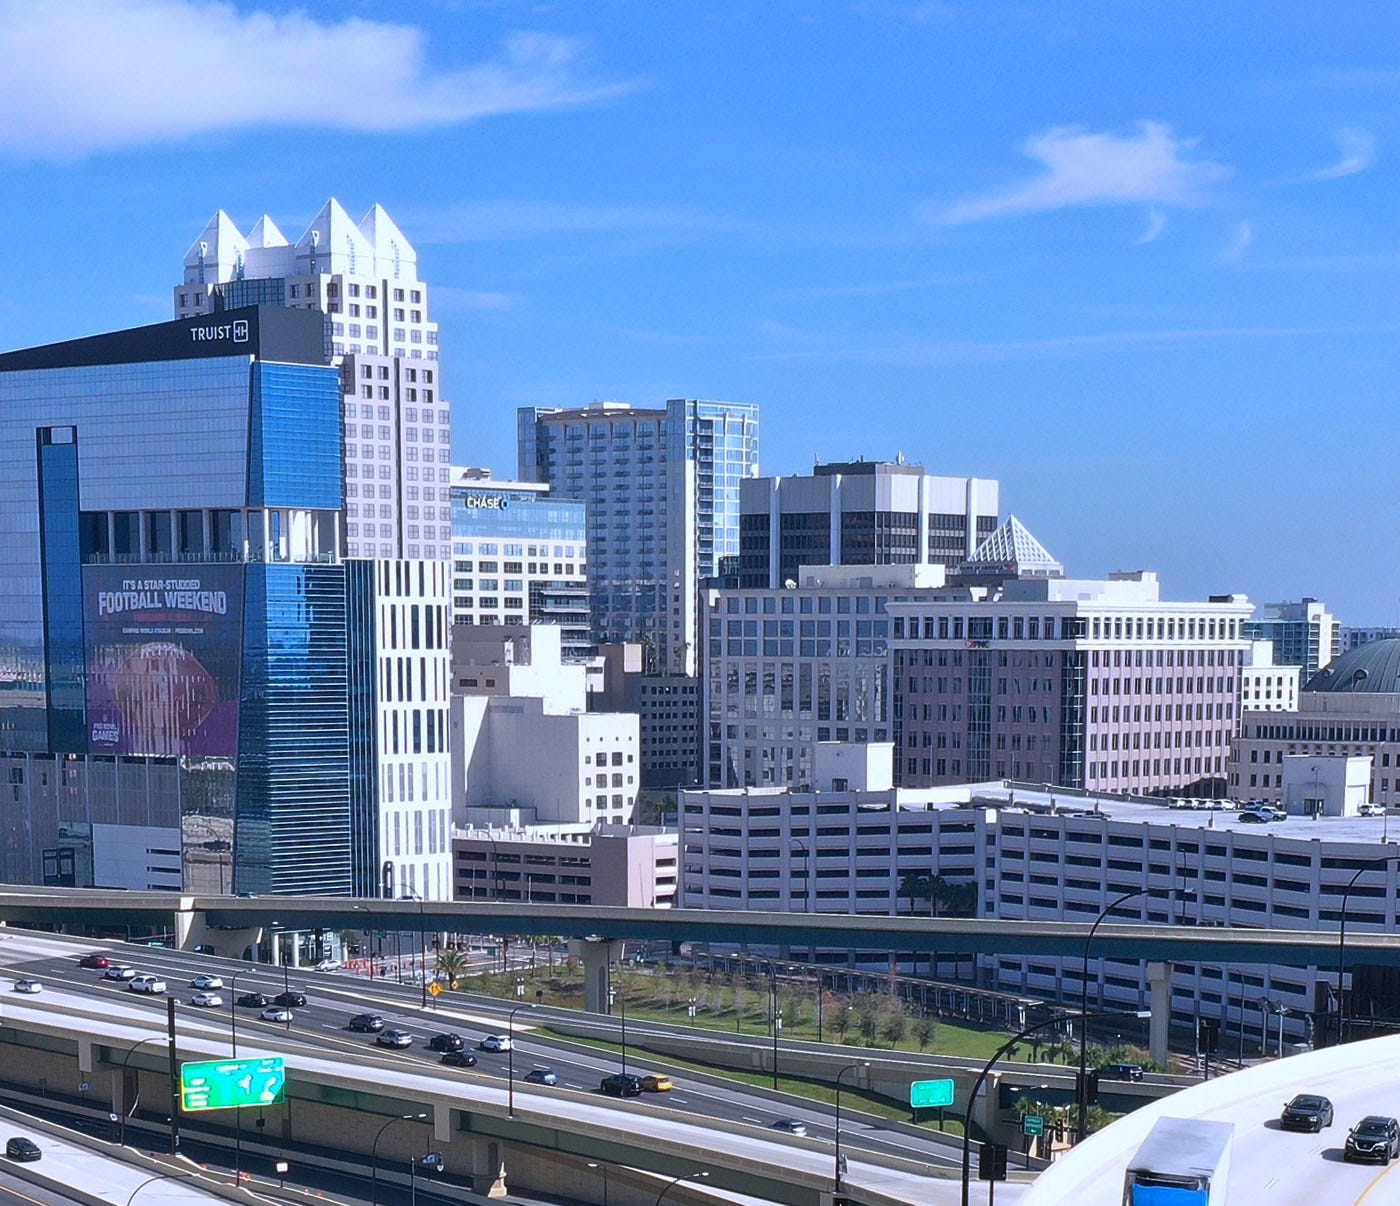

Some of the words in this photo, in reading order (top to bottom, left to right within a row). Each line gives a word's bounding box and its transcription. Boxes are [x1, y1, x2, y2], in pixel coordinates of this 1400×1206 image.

[190, 325, 232, 341] TRUIST
[467, 496, 500, 509] CHASE
[123, 580, 136, 590] IT'S
[137, 580, 143, 590] A
[144, 579, 200, 590] STAR-STUDDED
[99, 591, 162, 615] FOOTBALL
[164, 591, 227, 615] WEEKEND
[92, 730, 119, 742] GAMES
